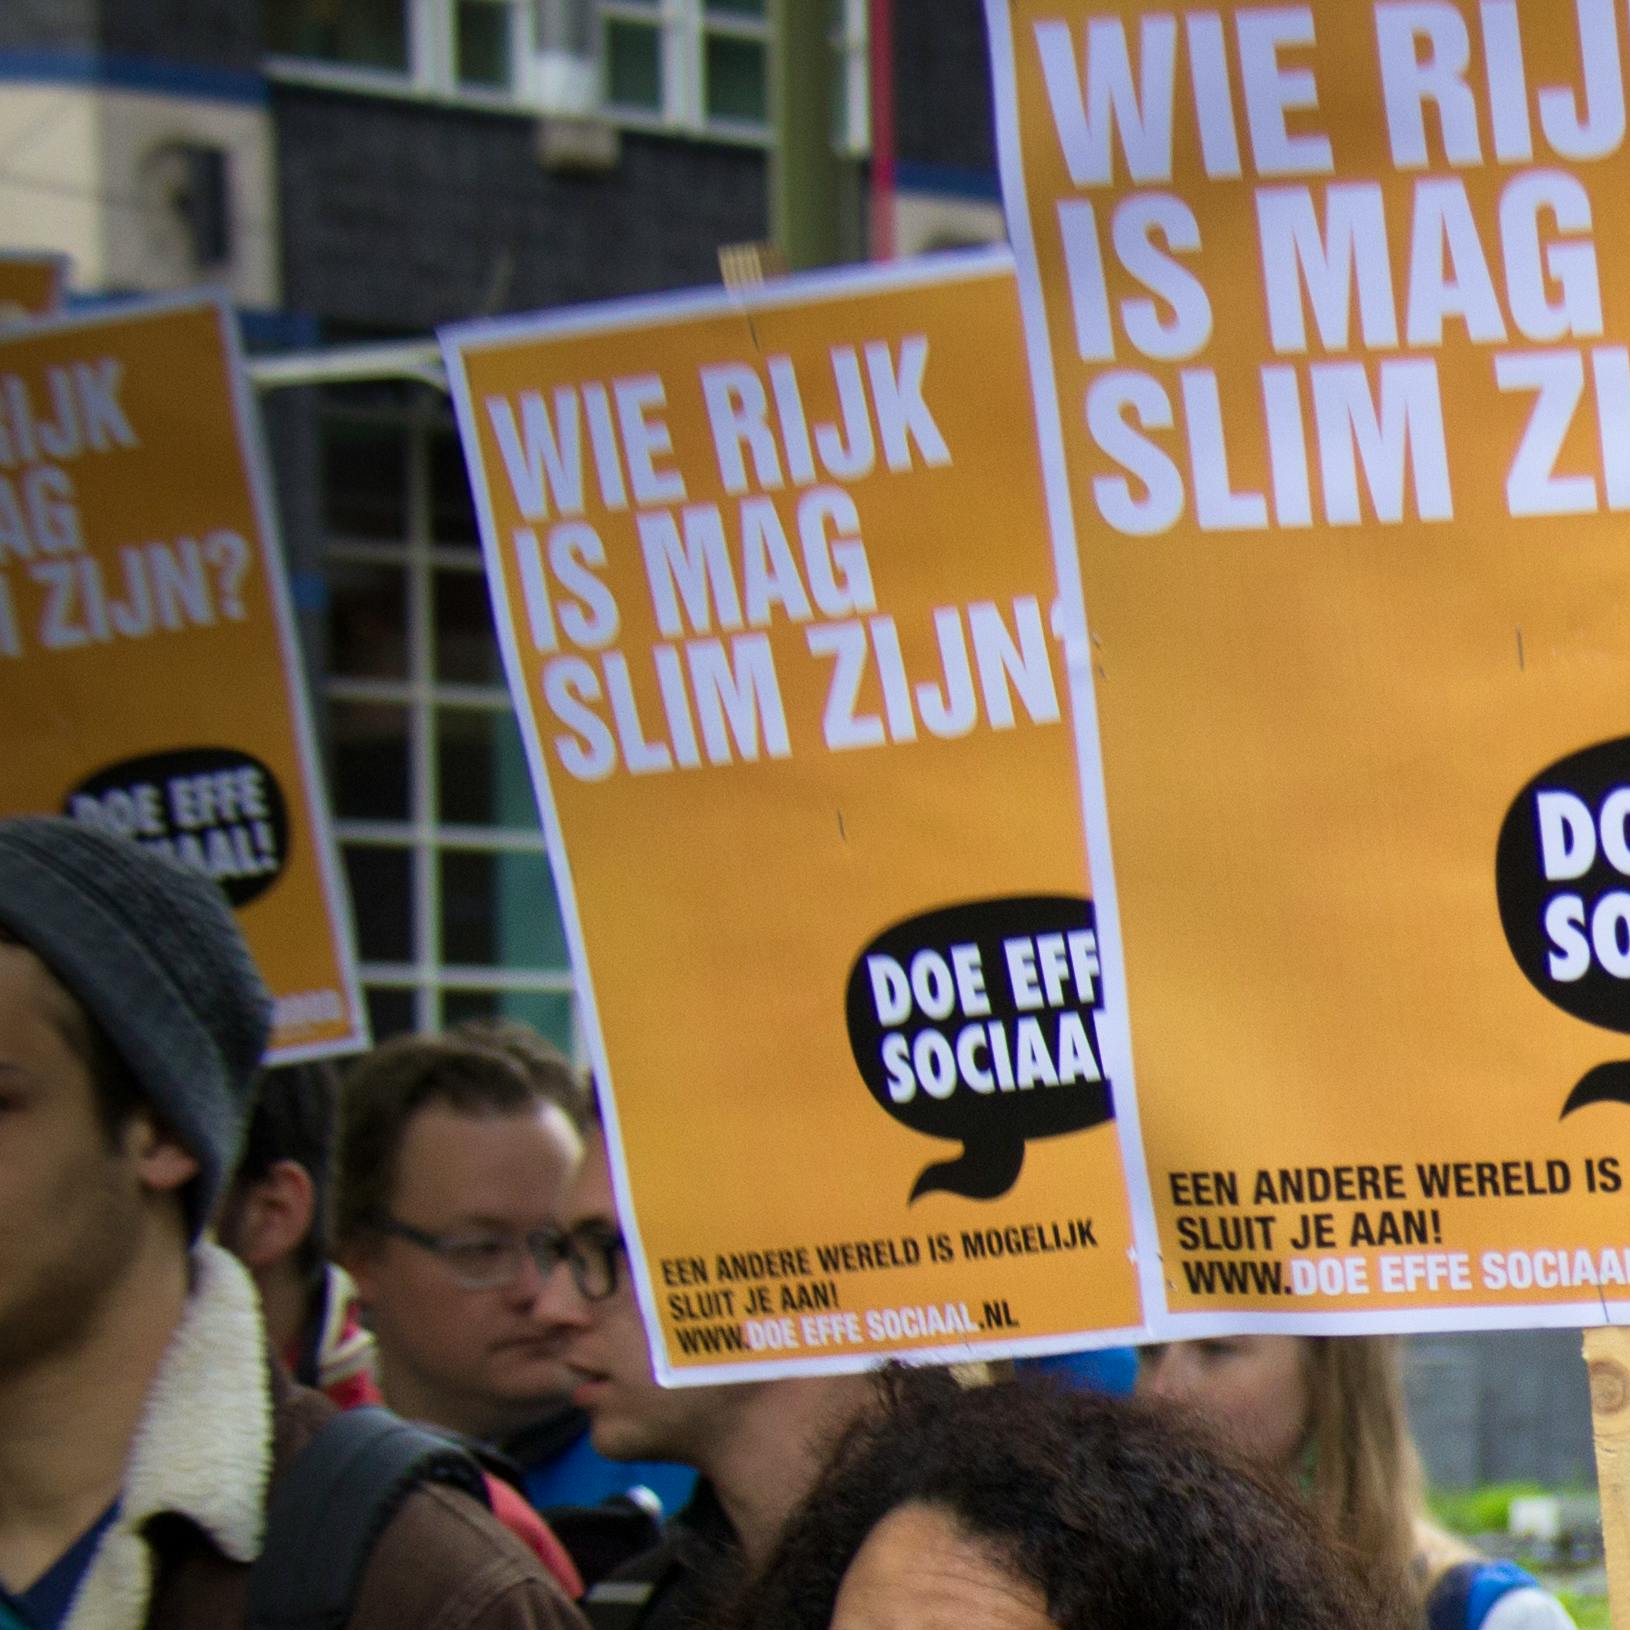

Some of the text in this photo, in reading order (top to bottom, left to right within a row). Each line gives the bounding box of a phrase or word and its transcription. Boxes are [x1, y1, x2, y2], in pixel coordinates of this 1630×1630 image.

[1033, 3, 1335, 187] WIE
[1056, 168, 1605, 361] IS MAG
[485, 333, 954, 522] WIE RIJK
[1083, 357, 1455, 537] SLIM
[0, 466, 86, 565] AG
[27, 526, 251, 651] ZIJN?
[513, 484, 879, 654] IS MAG
[541, 630, 792, 783] SLIM
[167, 765, 268, 830] EFFE
[866, 928, 1102, 1027] DOE EFF
[1168, 1171, 1238, 1207] EEN
[1252, 1163, 1406, 1205] ANDERE
[1416, 1159, 1572, 1200] WERELD
[1584, 1157, 1623, 1194] IS
[1176, 1209, 1443, 1253] SLUIT JE AAN!
[662, 1216, 1098, 1287] EEN ANDERE WERELD IS MOGELIJK
[1380, 1251, 1471, 1294] EFFE
[668, 1282, 840, 1322] SLUIT JE AAN!
[801, 1312, 861, 1350] EFFE
